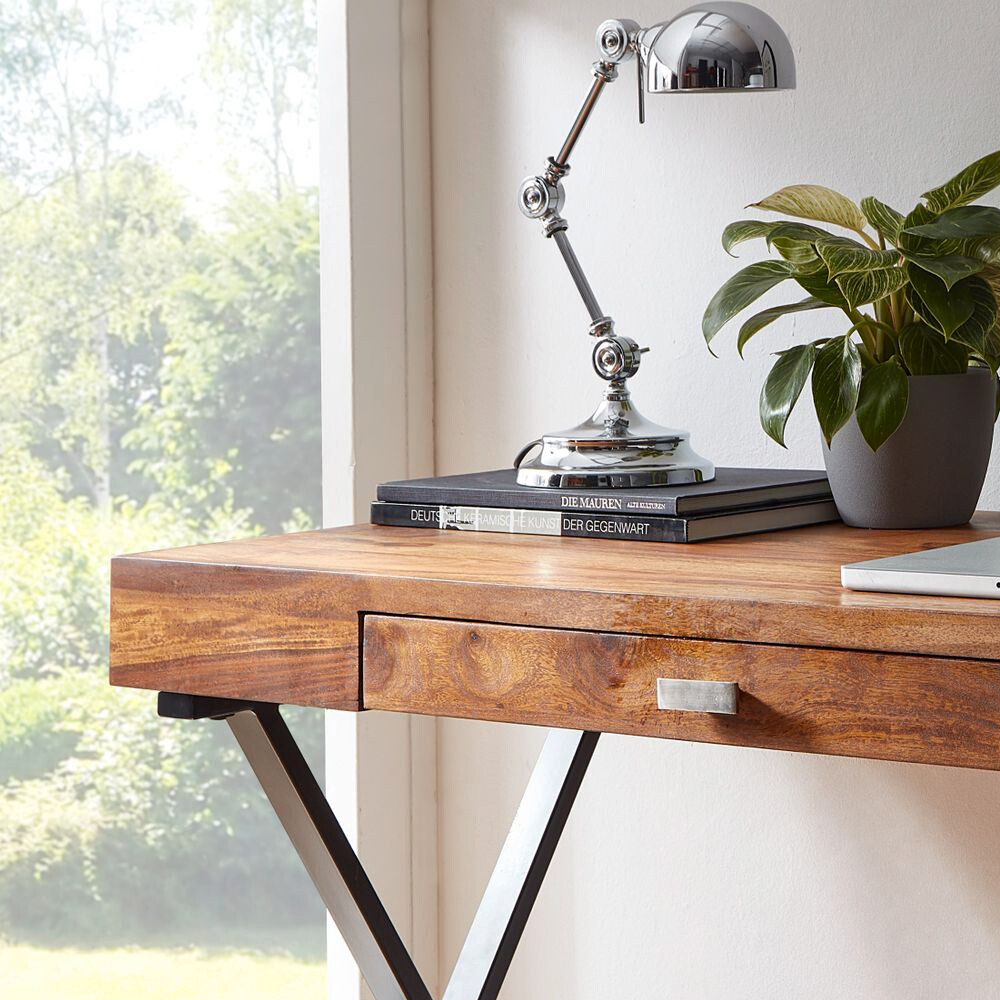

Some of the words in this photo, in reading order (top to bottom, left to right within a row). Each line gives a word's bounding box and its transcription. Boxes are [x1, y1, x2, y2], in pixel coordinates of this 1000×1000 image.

[561, 496, 578, 507] DIE
[579, 496, 622, 509] MAUREN
[410, 509, 461, 523] DEUTS
[528, 515, 561, 529] KUNST
[563, 518, 583, 531] DER
[585, 520, 650, 535] GEGENWART
